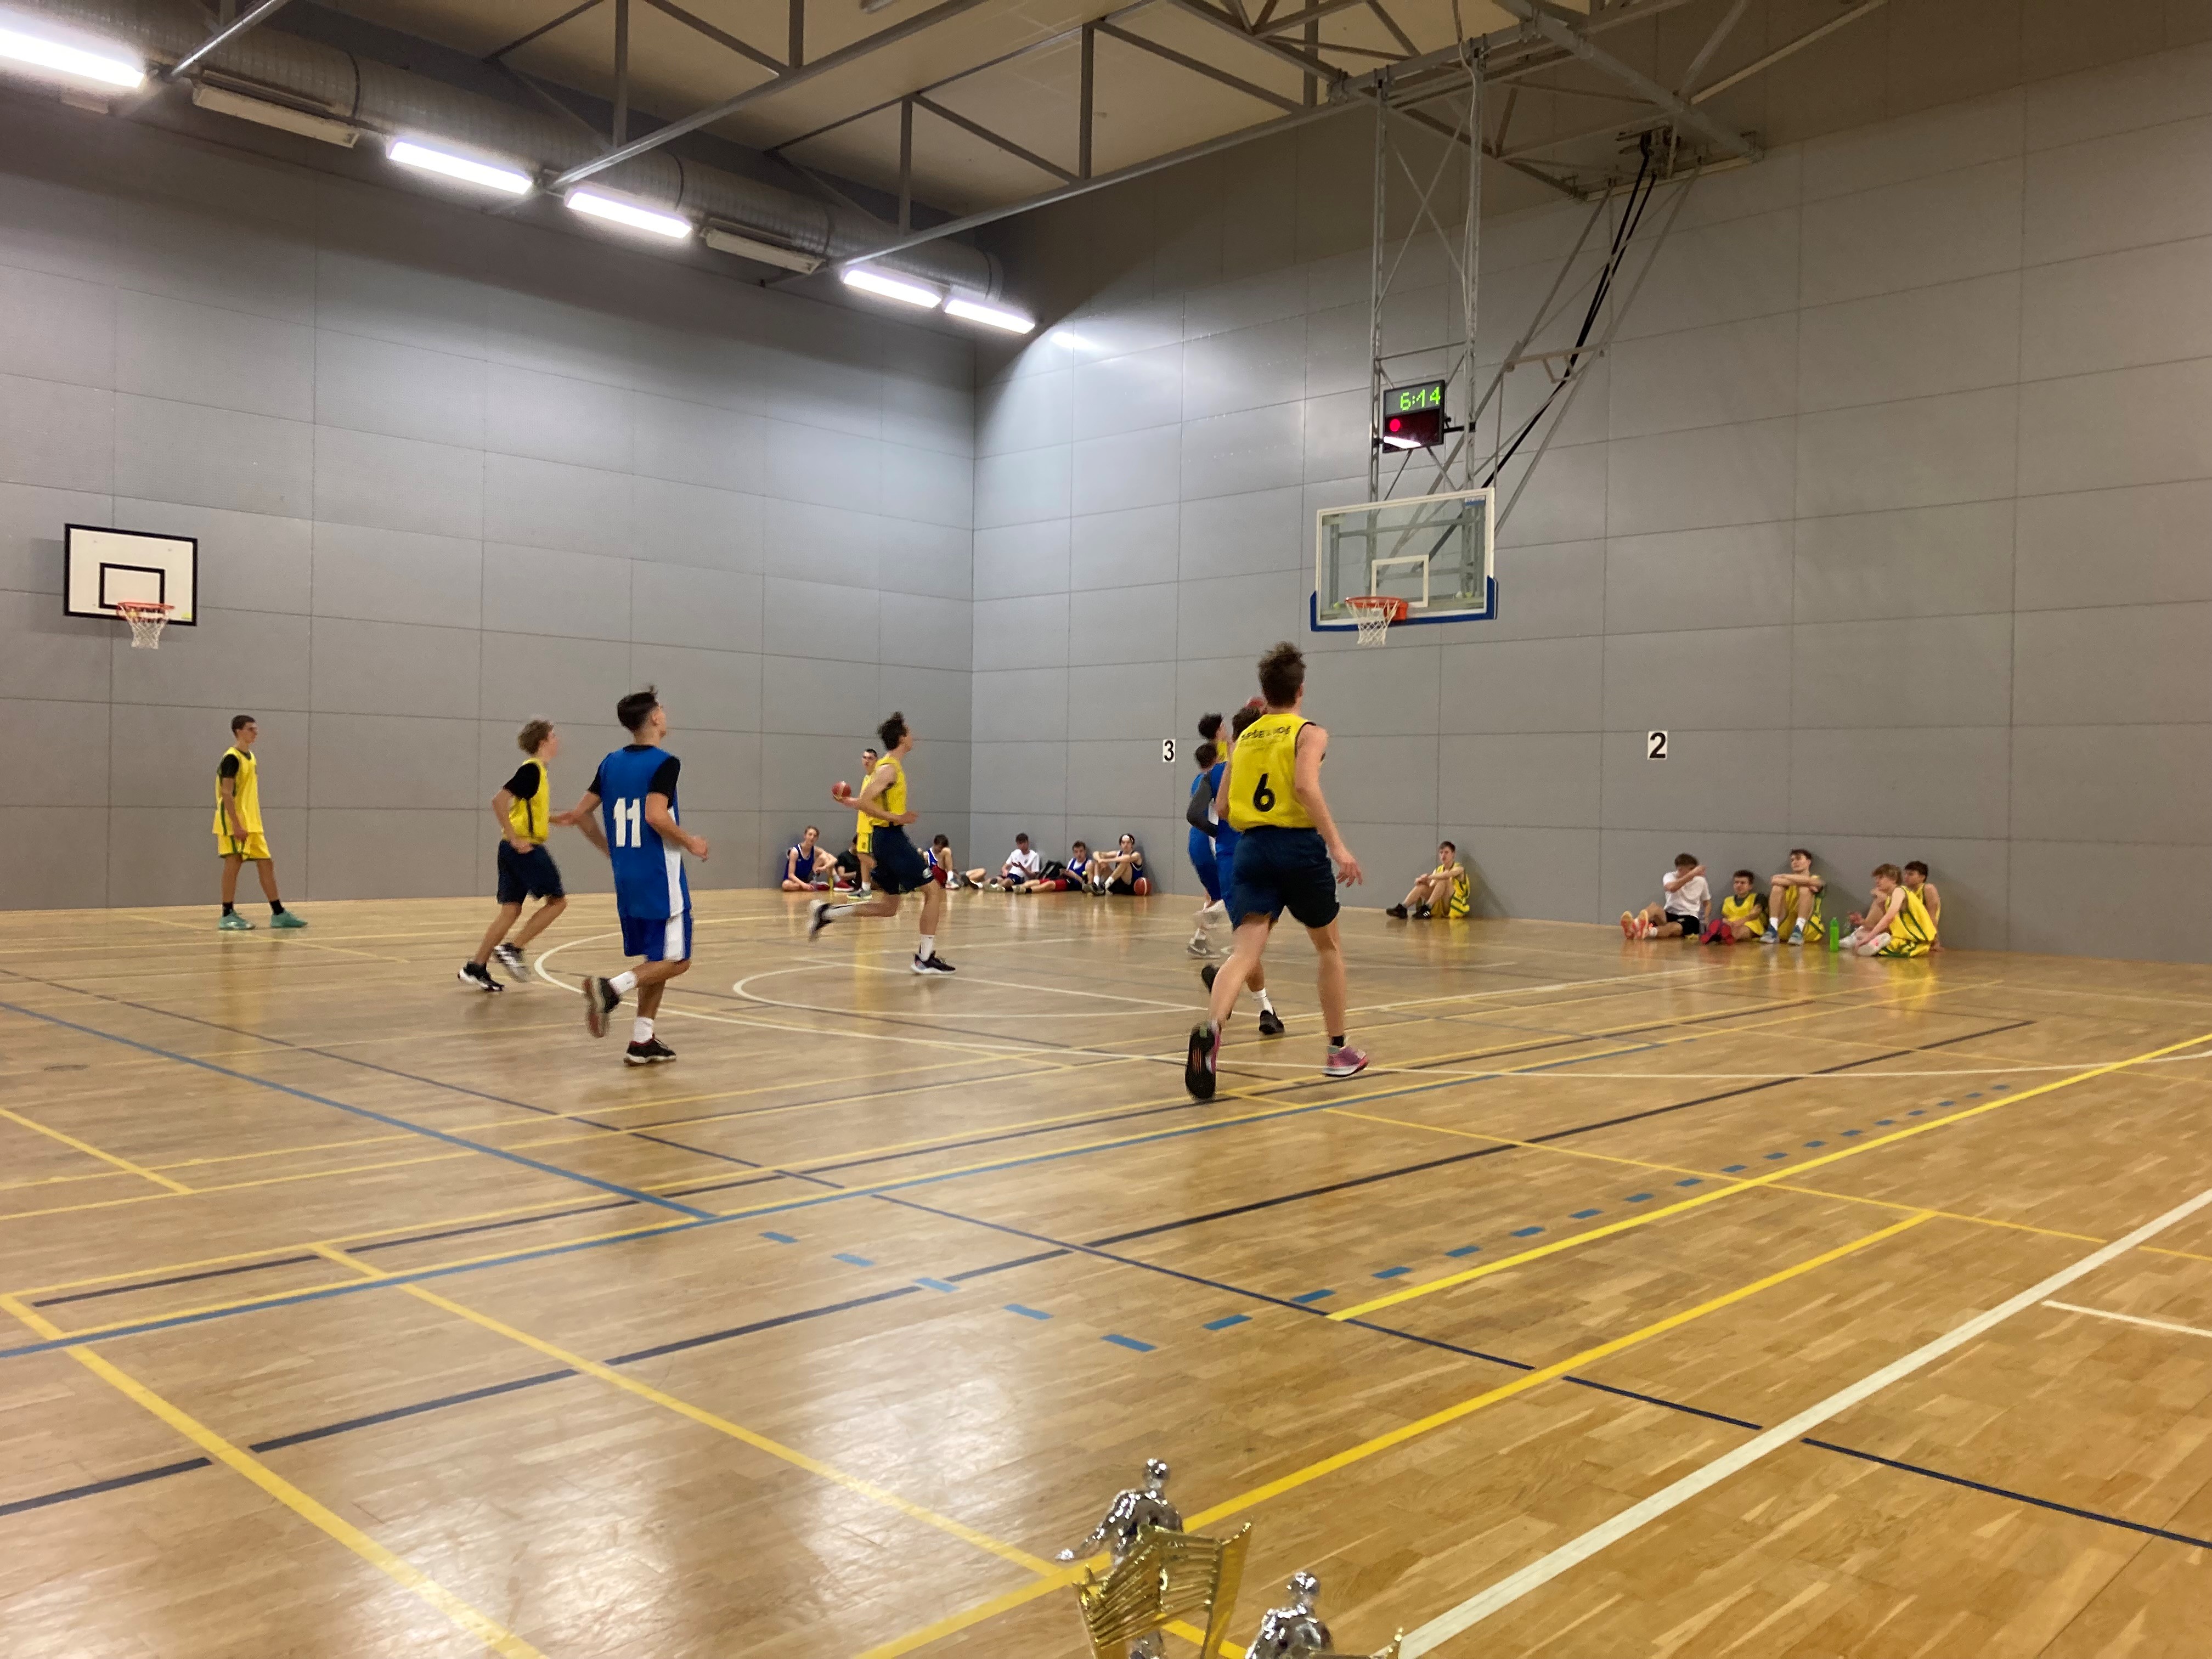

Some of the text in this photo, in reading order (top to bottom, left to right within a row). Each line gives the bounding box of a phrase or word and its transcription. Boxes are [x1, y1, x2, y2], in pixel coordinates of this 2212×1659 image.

[1400, 386, 1441, 411] 6:14
[1164, 740, 1174, 761] 3
[1650, 732, 1666, 758] 2
[1253, 773, 1276, 812] 6
[613, 797, 642, 848] 11
